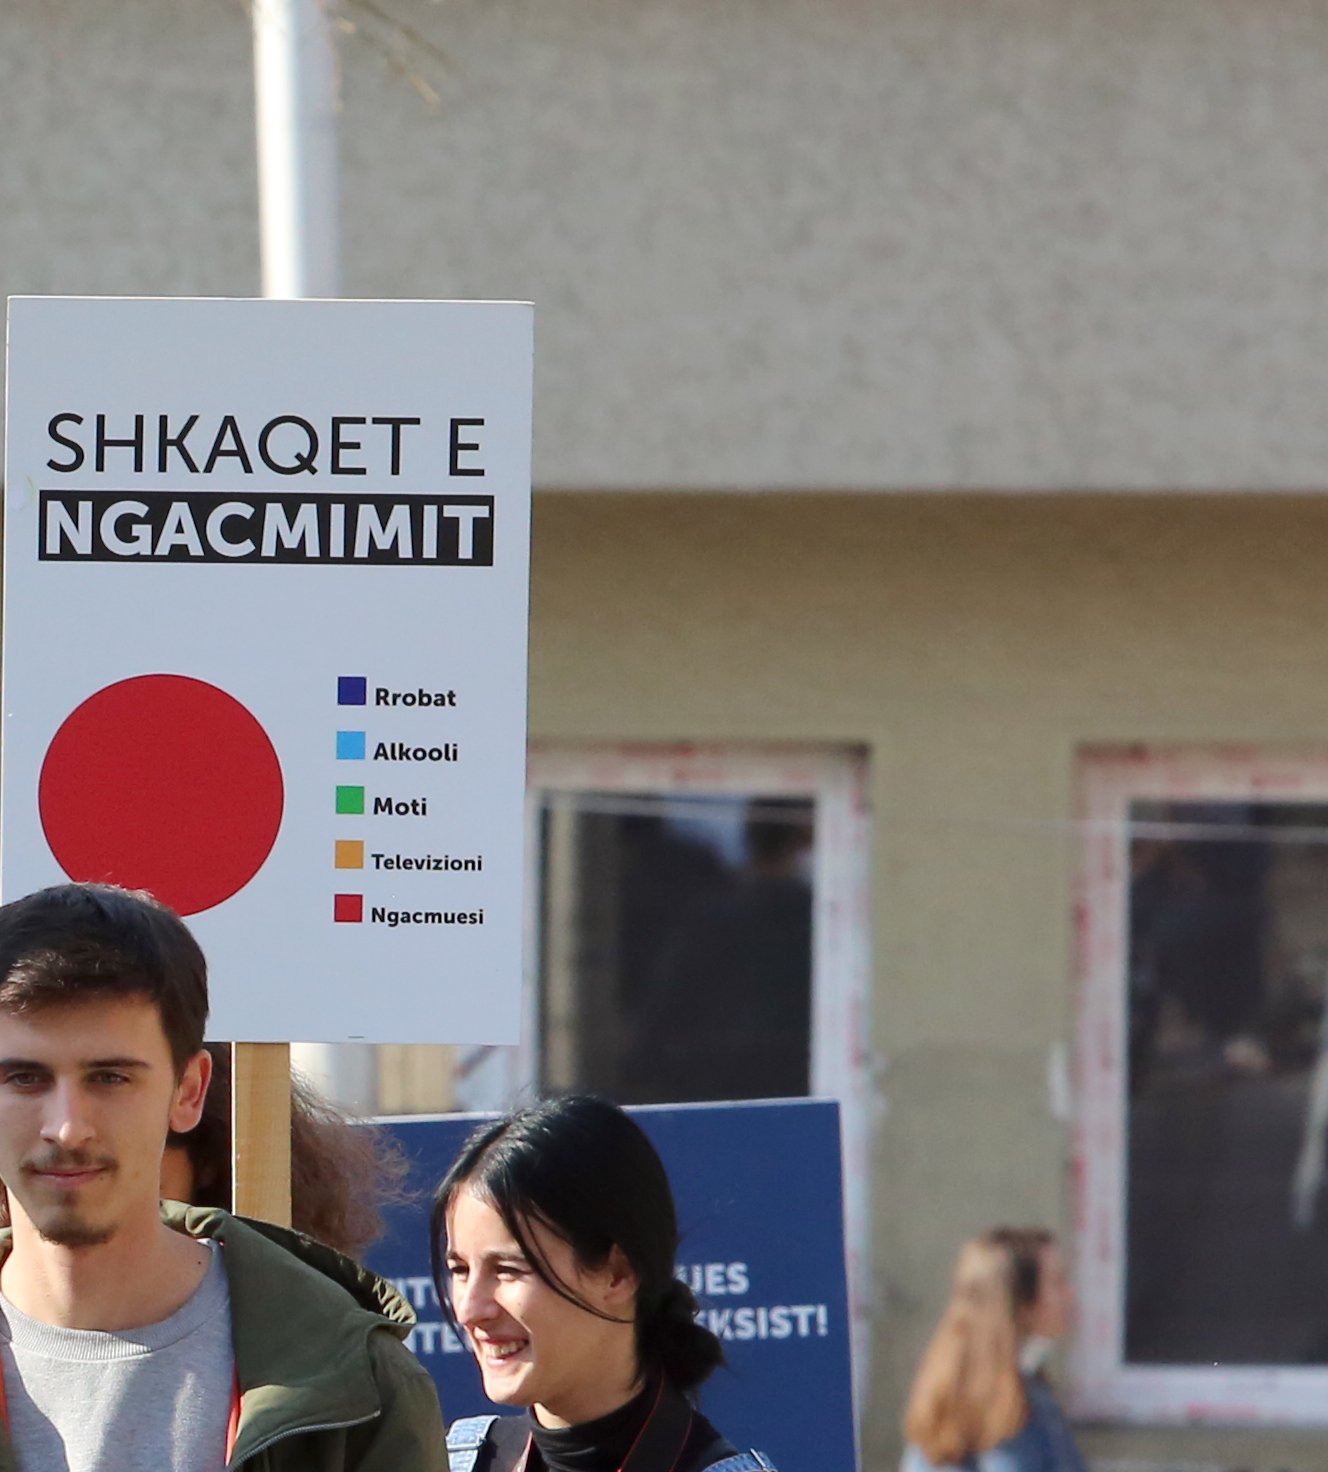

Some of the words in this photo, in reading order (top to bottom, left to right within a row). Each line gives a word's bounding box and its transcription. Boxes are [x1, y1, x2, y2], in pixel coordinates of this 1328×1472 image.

[47, 411, 421, 477] SHKAQET
[450, 417, 486, 477] E
[44, 498, 491, 561] NGACMIMIT
[374, 685, 457, 709] Rrobat
[372, 740, 458, 764] Alkooli
[372, 796, 428, 817] Moti
[371, 852, 483, 873] Televizioni
[370, 906, 485, 928] Ngacmuesi
